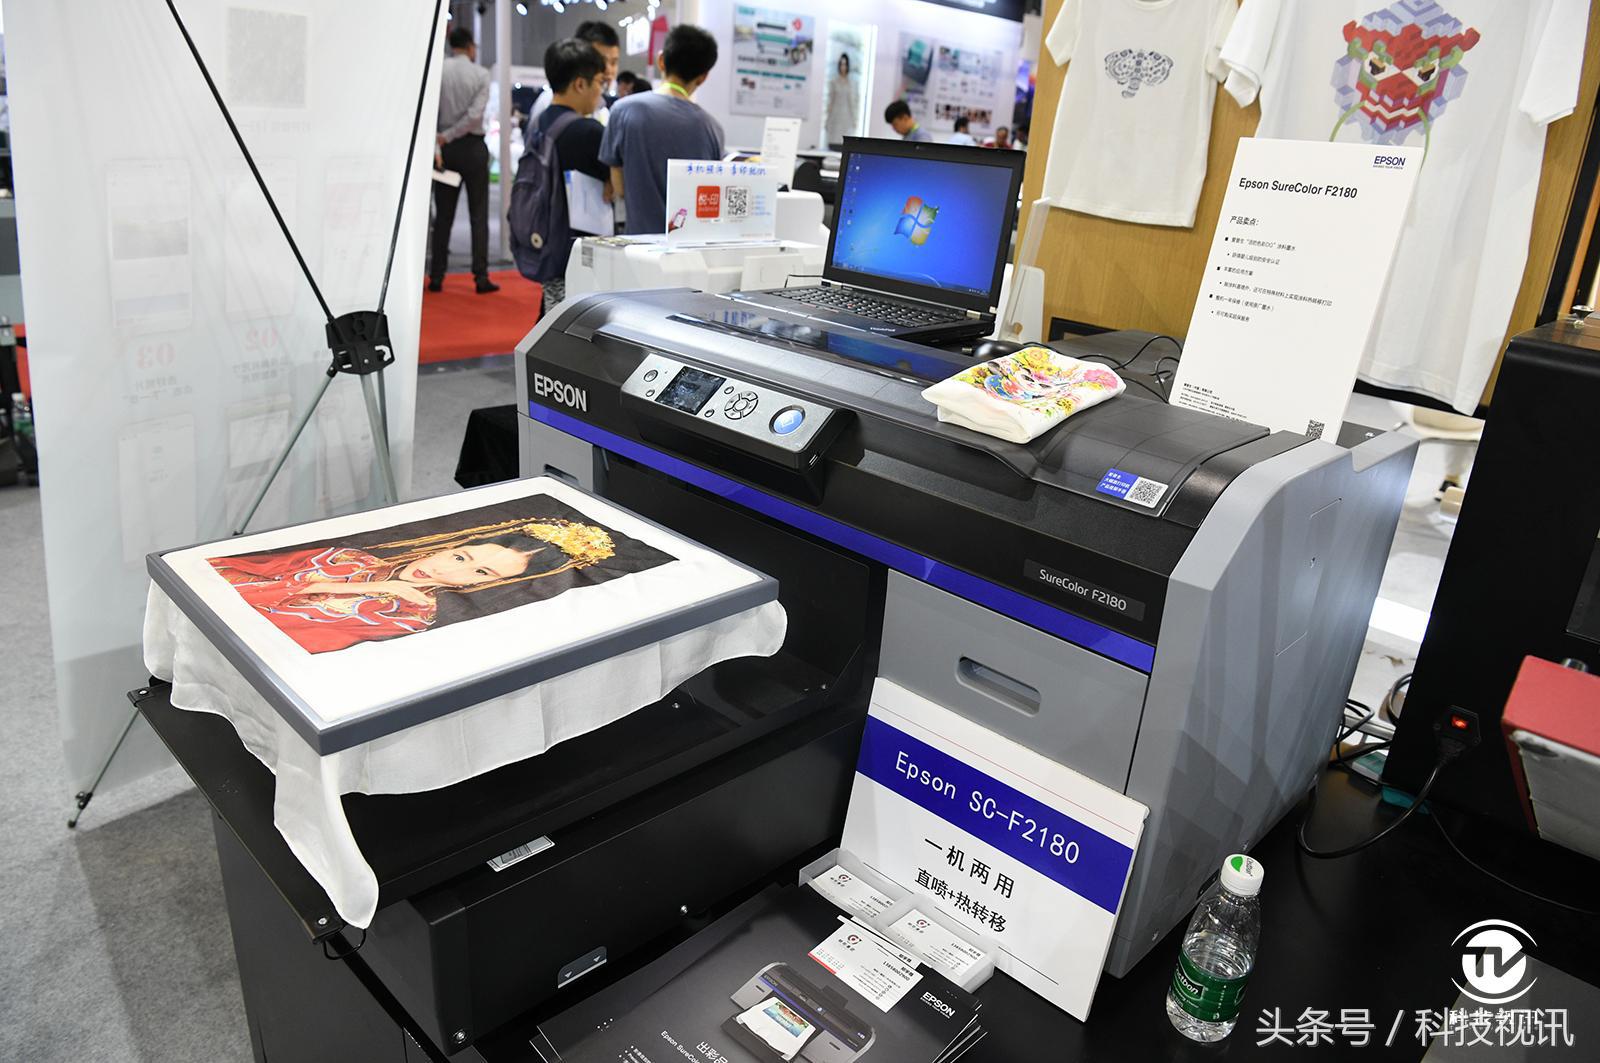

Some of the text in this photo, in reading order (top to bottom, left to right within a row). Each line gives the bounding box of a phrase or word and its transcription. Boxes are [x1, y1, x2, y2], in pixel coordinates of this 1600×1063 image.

[1374, 155, 1406, 166] EPSON
[1239, 177, 1358, 199] Epson SureColor F2180
[533, 372, 587, 412] EPSON
[1040, 569, 1127, 611] SureColor F2180
[895, 750, 1081, 865] Epson SC-F2180
[924, 838, 1016, 899] 一机两用
[914, 867, 1008, 934] 直喷+热转移
[922, 991, 956, 1017] EPSON
[661, 1030, 678, 1047] Epson
[677, 1044, 701, 1063] SureCol
